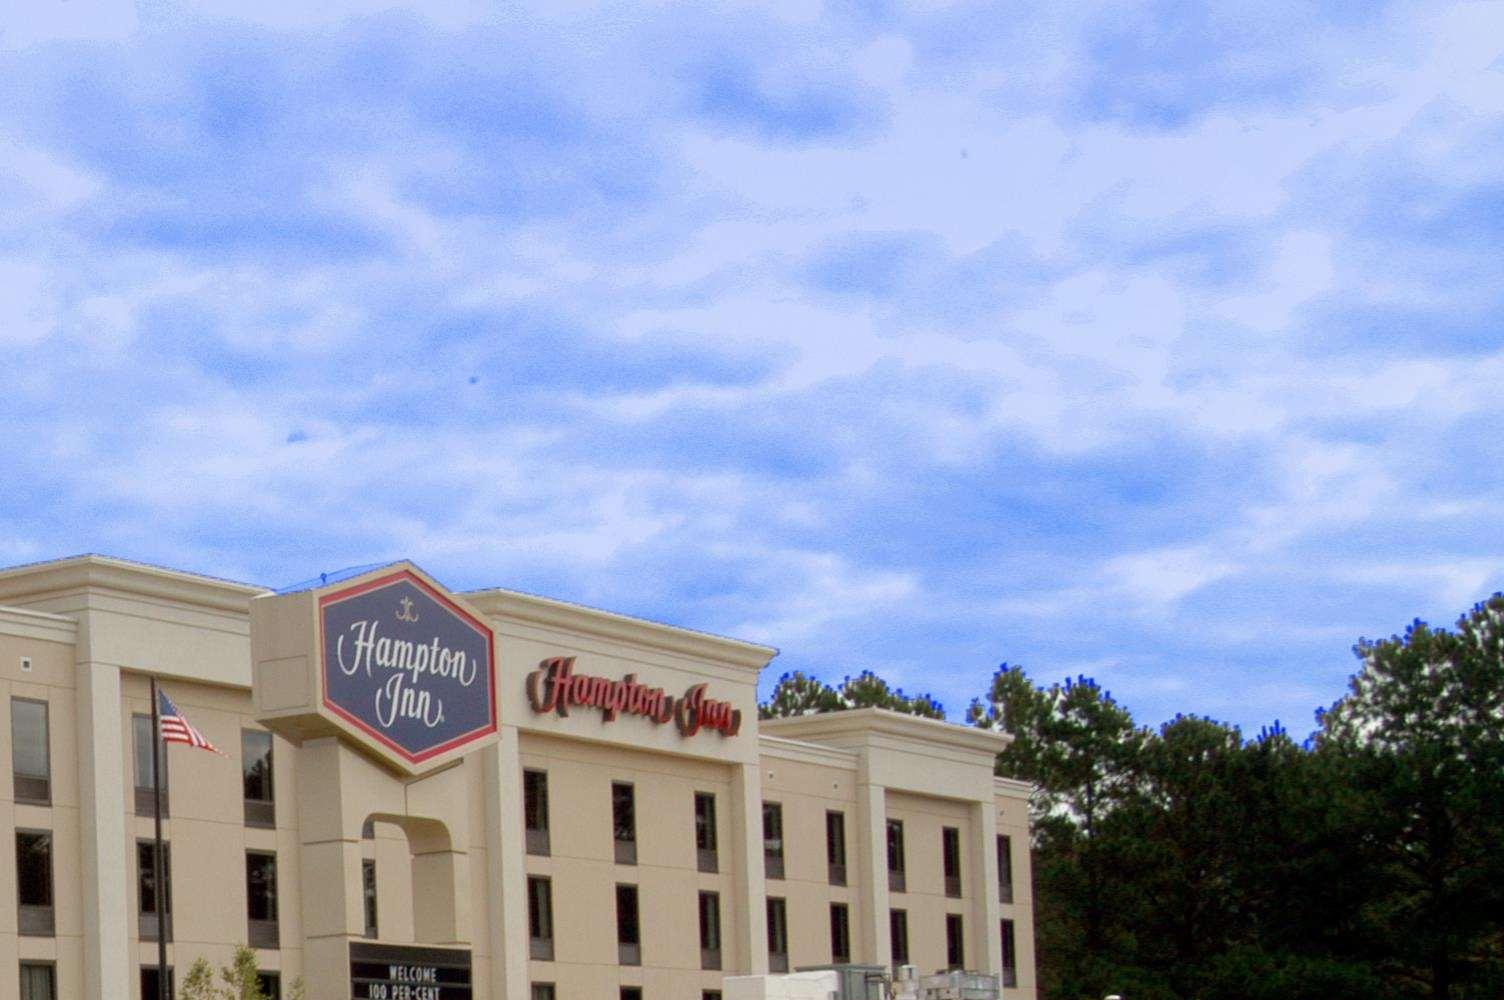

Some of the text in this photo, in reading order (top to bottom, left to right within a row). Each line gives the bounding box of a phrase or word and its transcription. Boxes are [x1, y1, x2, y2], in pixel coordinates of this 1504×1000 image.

[337, 620, 477, 687] Hampton
[375, 672, 443, 728] Inn
[525, 656, 742, 738] Hampton Inn
[369, 984, 387, 1000] 100
[389, 965, 437, 983] WELCOME
